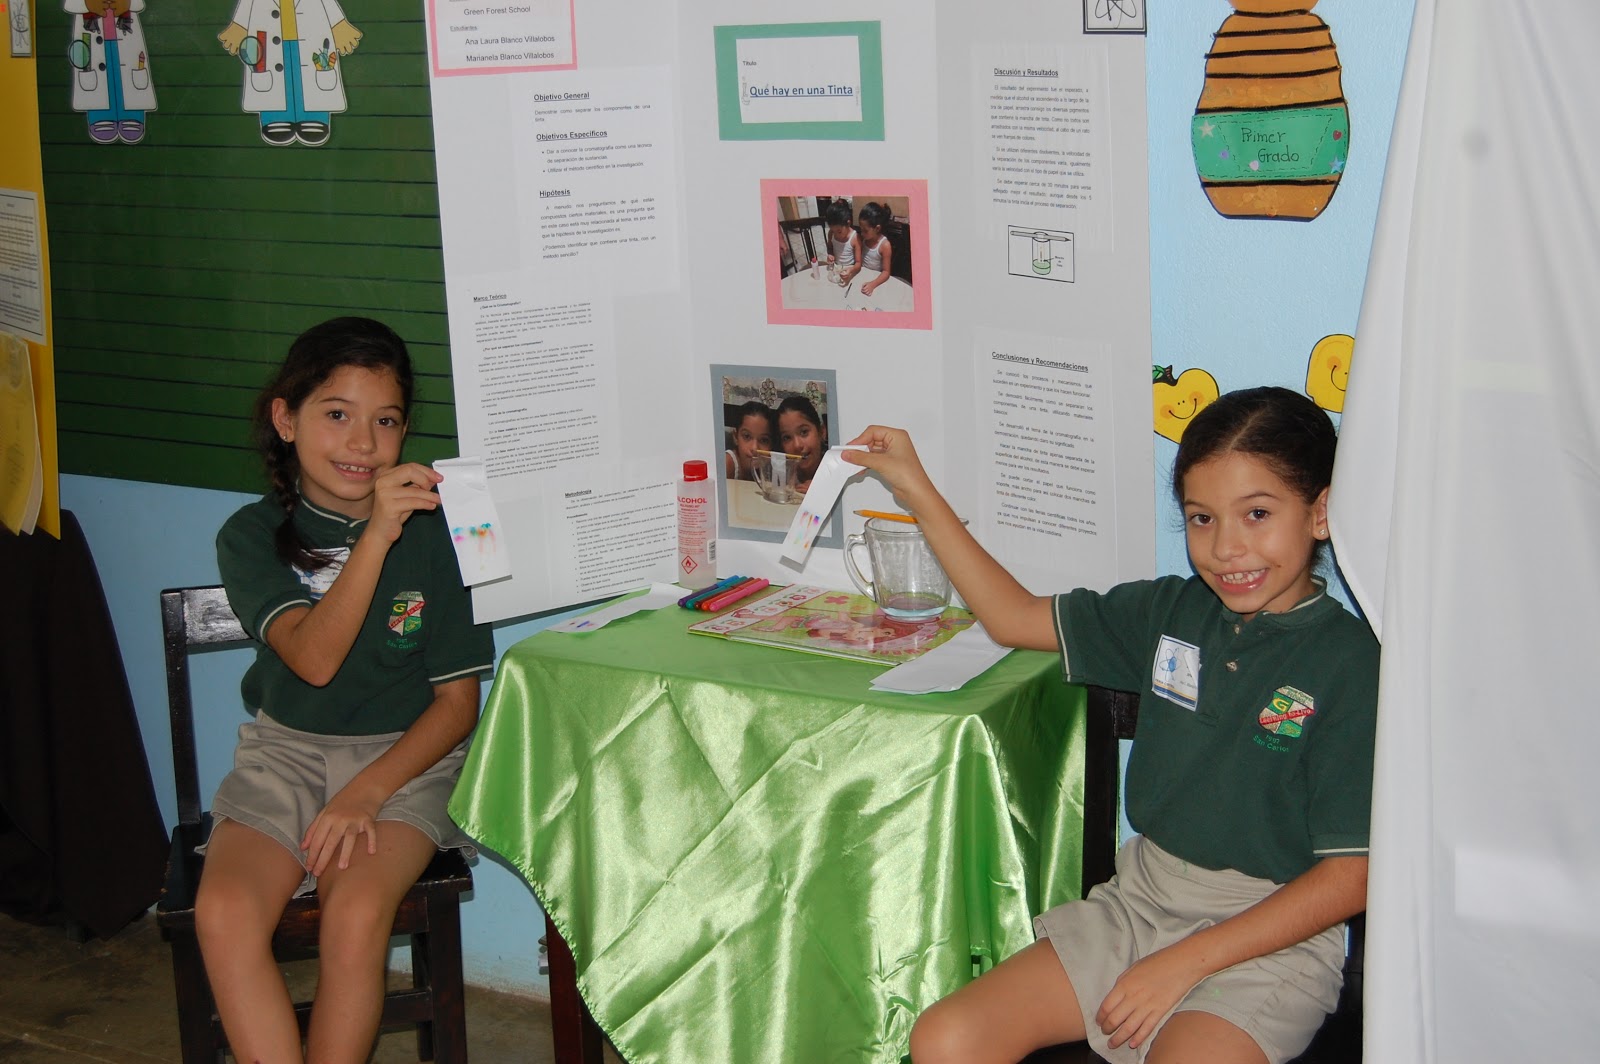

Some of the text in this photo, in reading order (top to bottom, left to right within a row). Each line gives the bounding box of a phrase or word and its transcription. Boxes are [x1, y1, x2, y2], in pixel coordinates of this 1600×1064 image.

[750, 85, 769, 96] Qué
[772, 86, 789, 97] hay
[828, 85, 853, 94] Tinta
[1241, 127, 1286, 143] Primer
[1258, 145, 1299, 162] Grado
[992, 352, 1030, 363] Conclusiones
[1036, 358, 1088, 371] Recomendaciones
[393, 604, 406, 612] G
[1272, 698, 1289, 712] G
